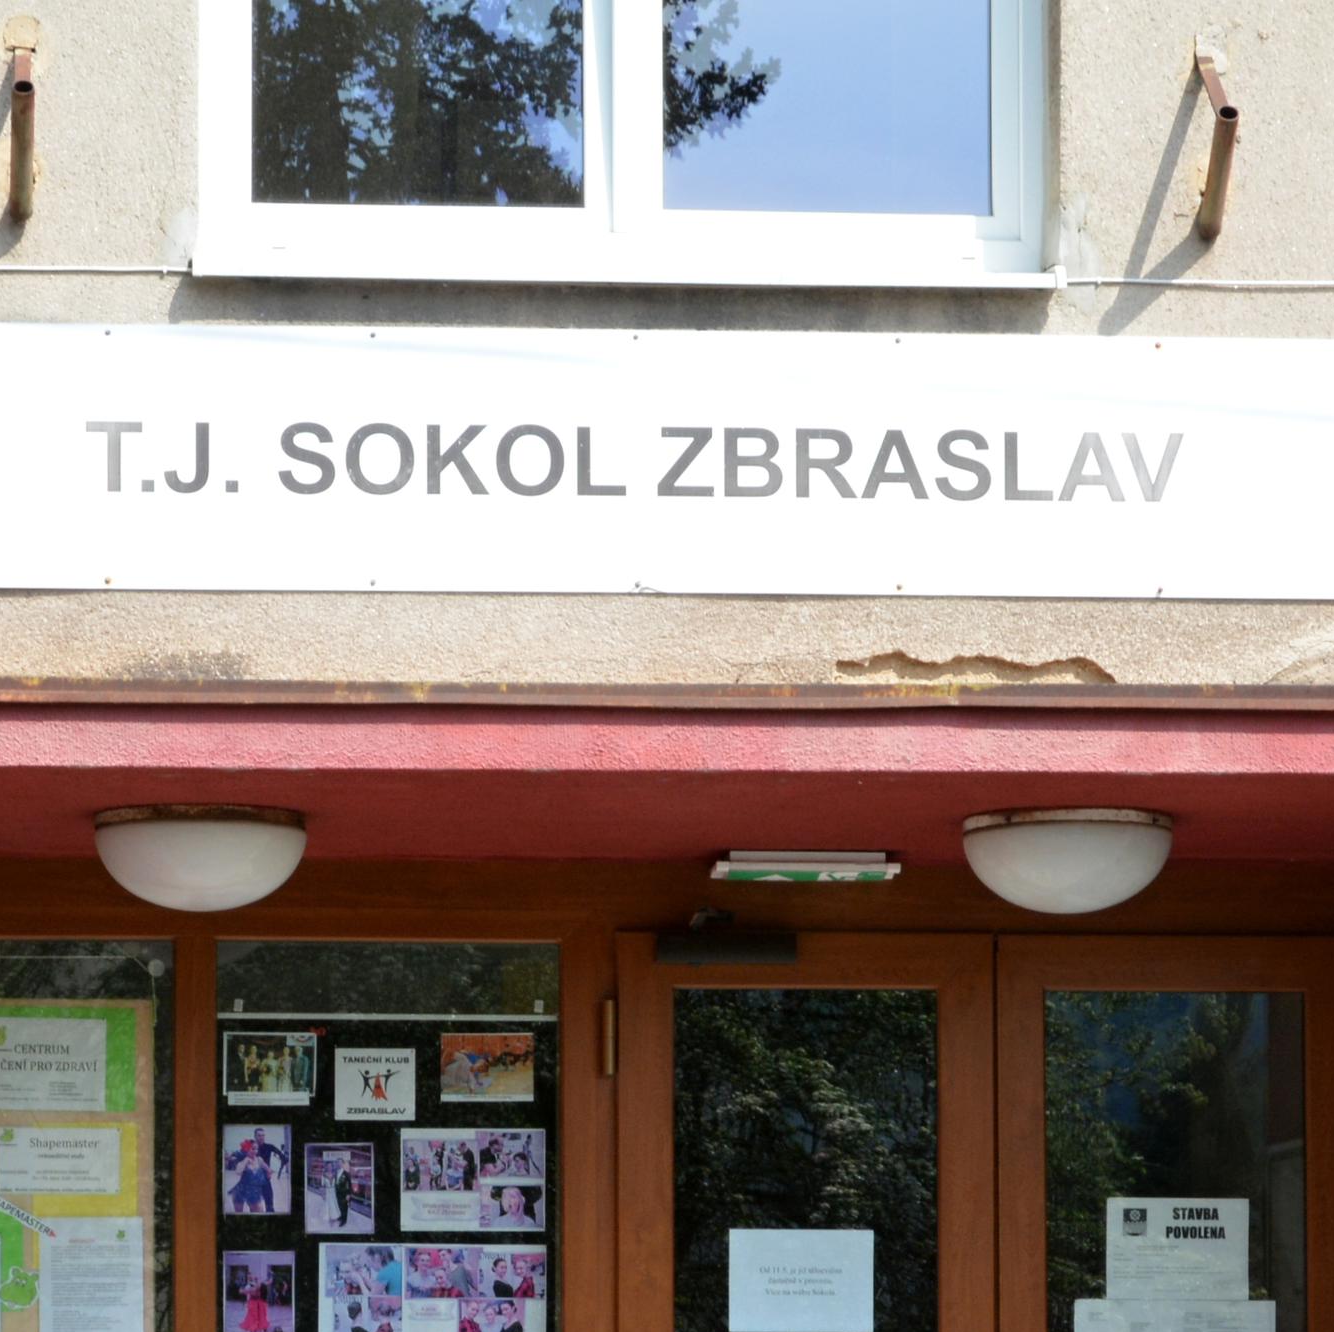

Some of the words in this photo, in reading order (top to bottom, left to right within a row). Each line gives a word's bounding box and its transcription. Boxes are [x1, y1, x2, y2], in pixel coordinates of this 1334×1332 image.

[85, 421, 239, 493] T.J.
[278, 421, 626, 496] SOKOL
[657, 426, 1183, 501] ZBRASLAV
[13, 1043, 70, 1055] CENTRUM
[30, 1060, 53, 1071] PRO
[55, 1059, 98, 1072] ZDRAVÍ
[343, 1055, 382, 1064] TANEČNÍ
[385, 1056, 410, 1064] KLUB
[347, 1107, 406, 1115] ZBRASLAV
[29, 1137, 100, 1150] Shapemaster
[1172, 1207, 1219, 1220] STAVBA
[1165, 1226, 1226, 1239] POVOLENA
